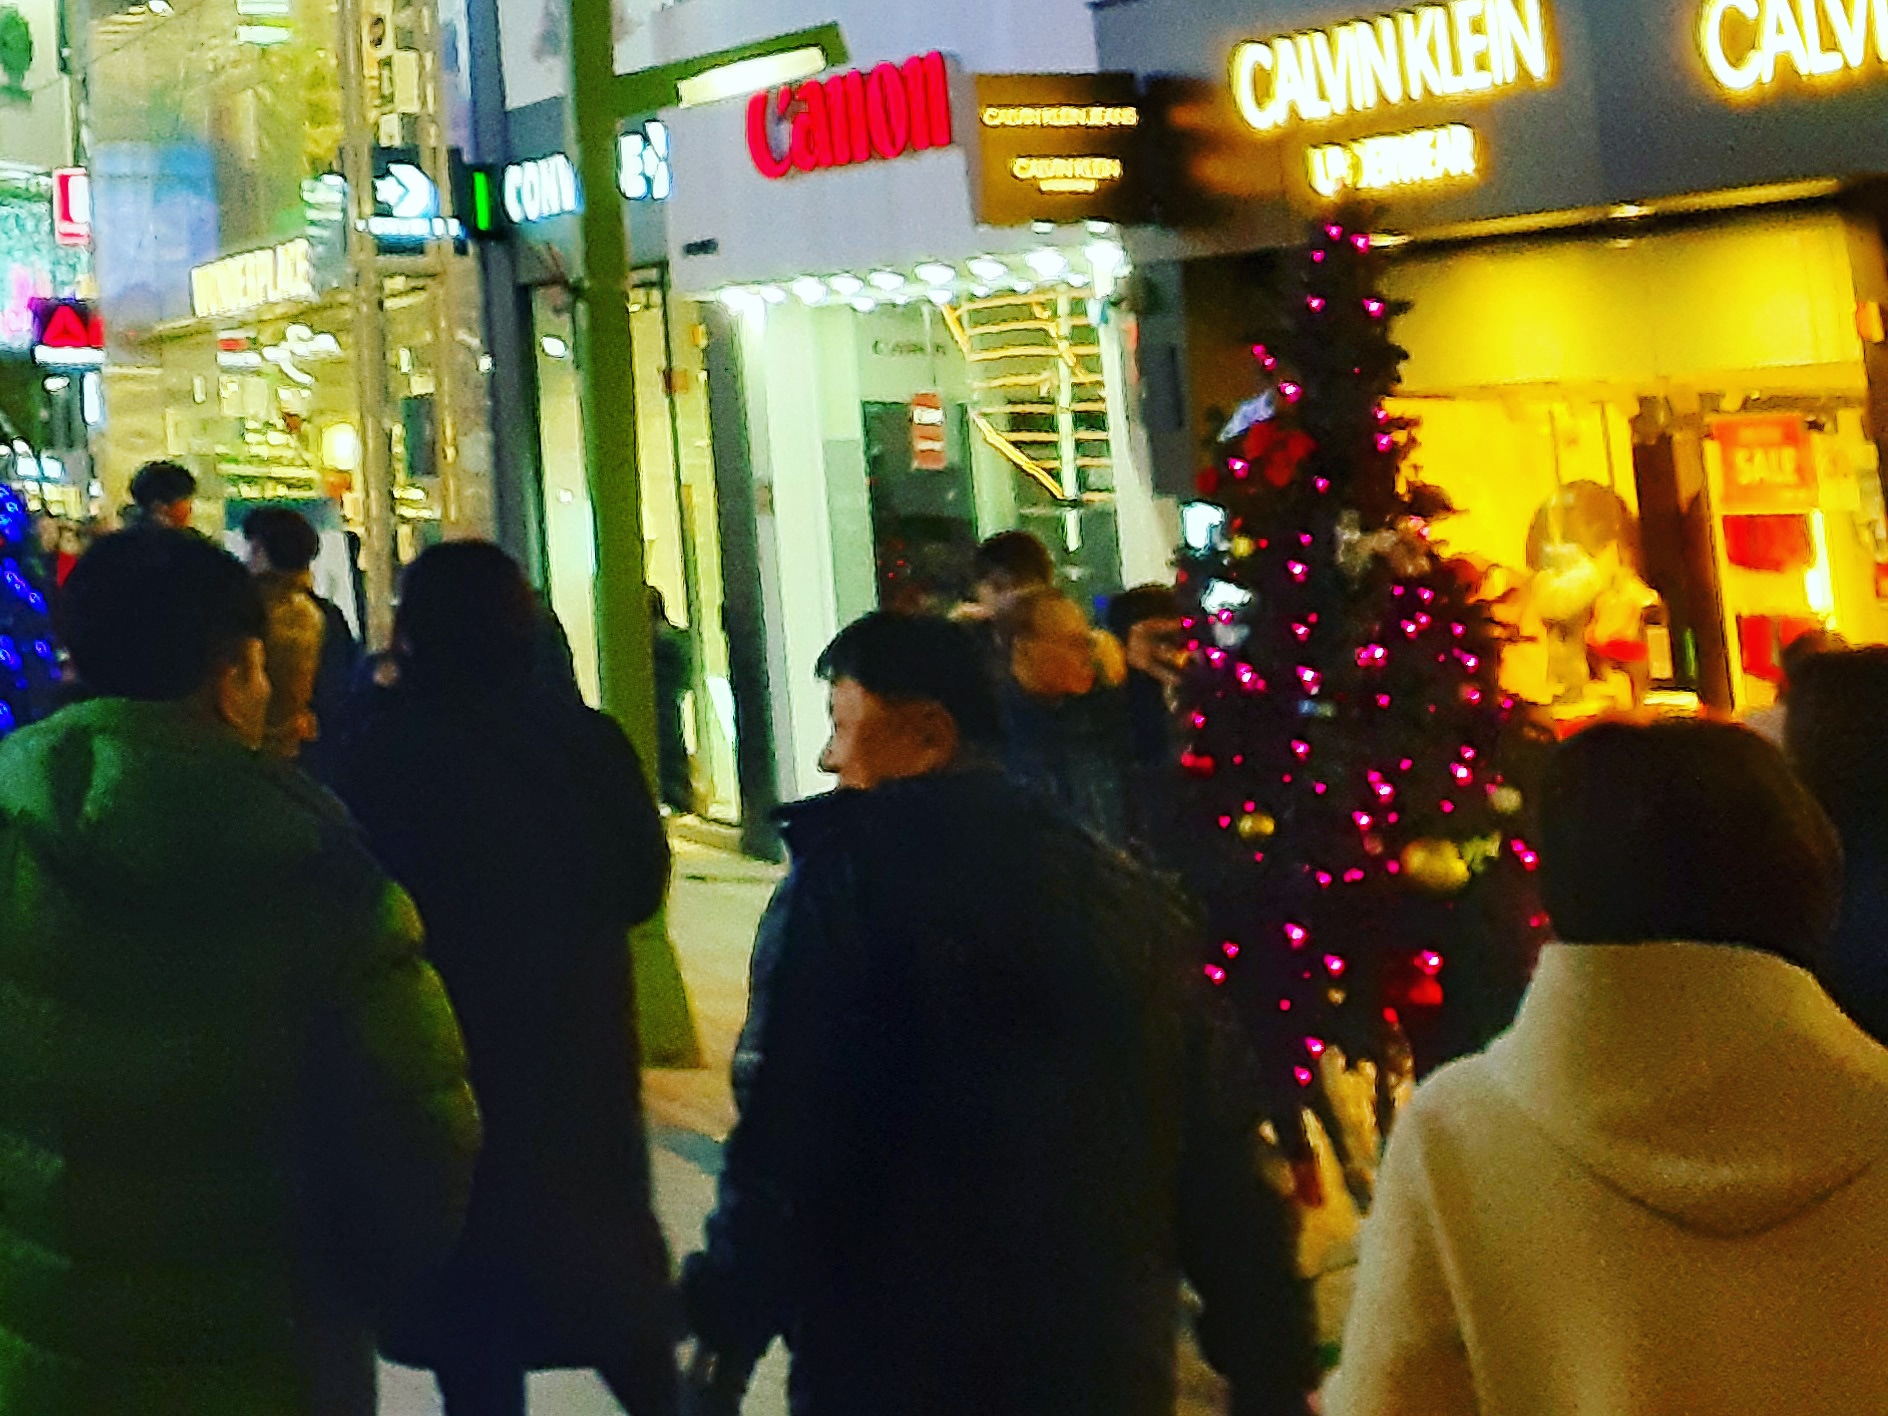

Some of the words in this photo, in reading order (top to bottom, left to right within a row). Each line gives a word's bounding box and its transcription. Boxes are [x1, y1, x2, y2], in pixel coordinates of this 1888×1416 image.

[746, 49, 952, 181] Canon
[1227, 13, 1404, 133] CALVIN
[1734, 445, 1799, 486] SALE
